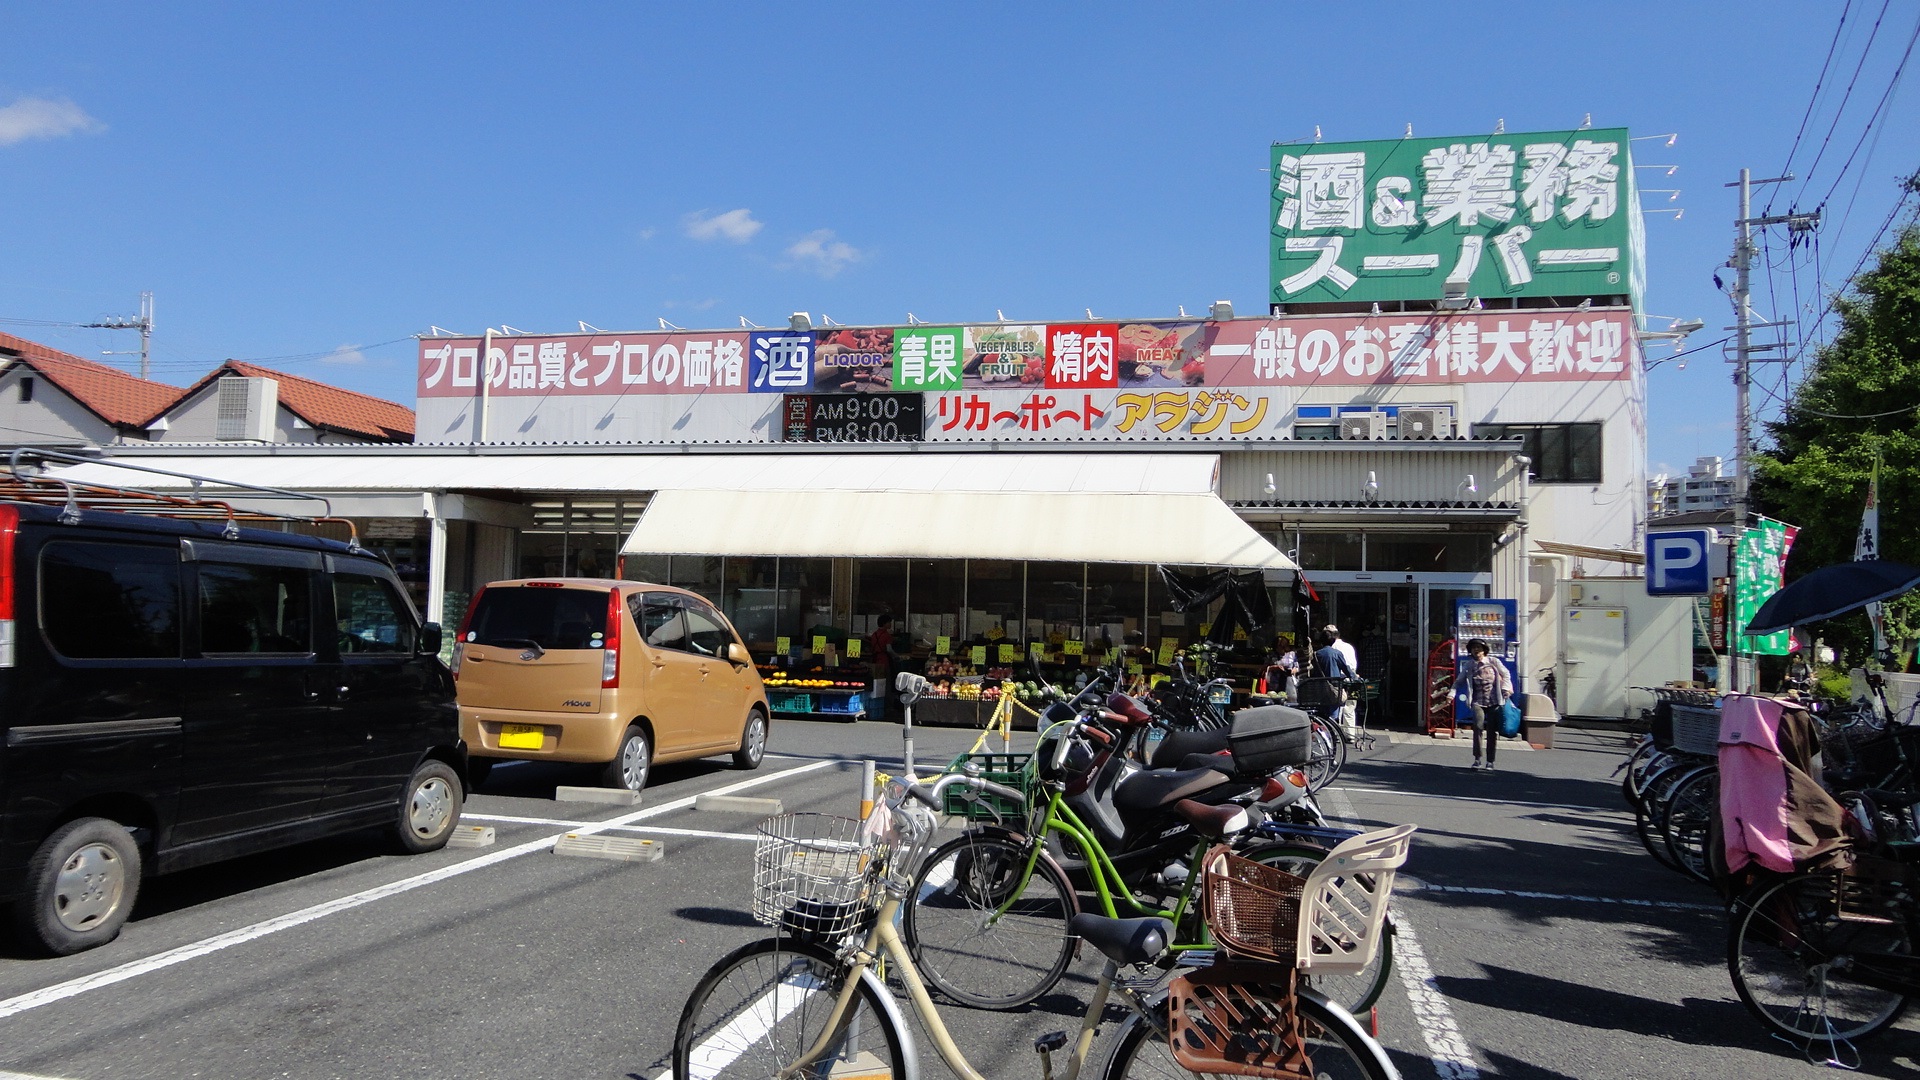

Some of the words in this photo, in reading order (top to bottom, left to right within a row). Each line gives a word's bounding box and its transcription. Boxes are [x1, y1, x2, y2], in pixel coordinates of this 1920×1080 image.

[1279, 225, 1620, 294] スーパー
[424, 339, 744, 389] プロの品質とプロの価格
[754, 337, 811, 388] 酒
[823, 353, 884, 367] LIQUOR
[899, 334, 957, 386] 青果
[974, 340, 1034, 353] VEGETABLES
[981, 363, 1027, 376] FRUIT
[998, 353, 1009, 364] &
[1051, 331, 1113, 383] 精肉
[1137, 348, 1184, 362] MEAT
[1210, 318, 1624, 379] 一般のお客様大歓迎
[1113, 389, 1269, 435] アラジン
[1653, 537, 1701, 588] P
